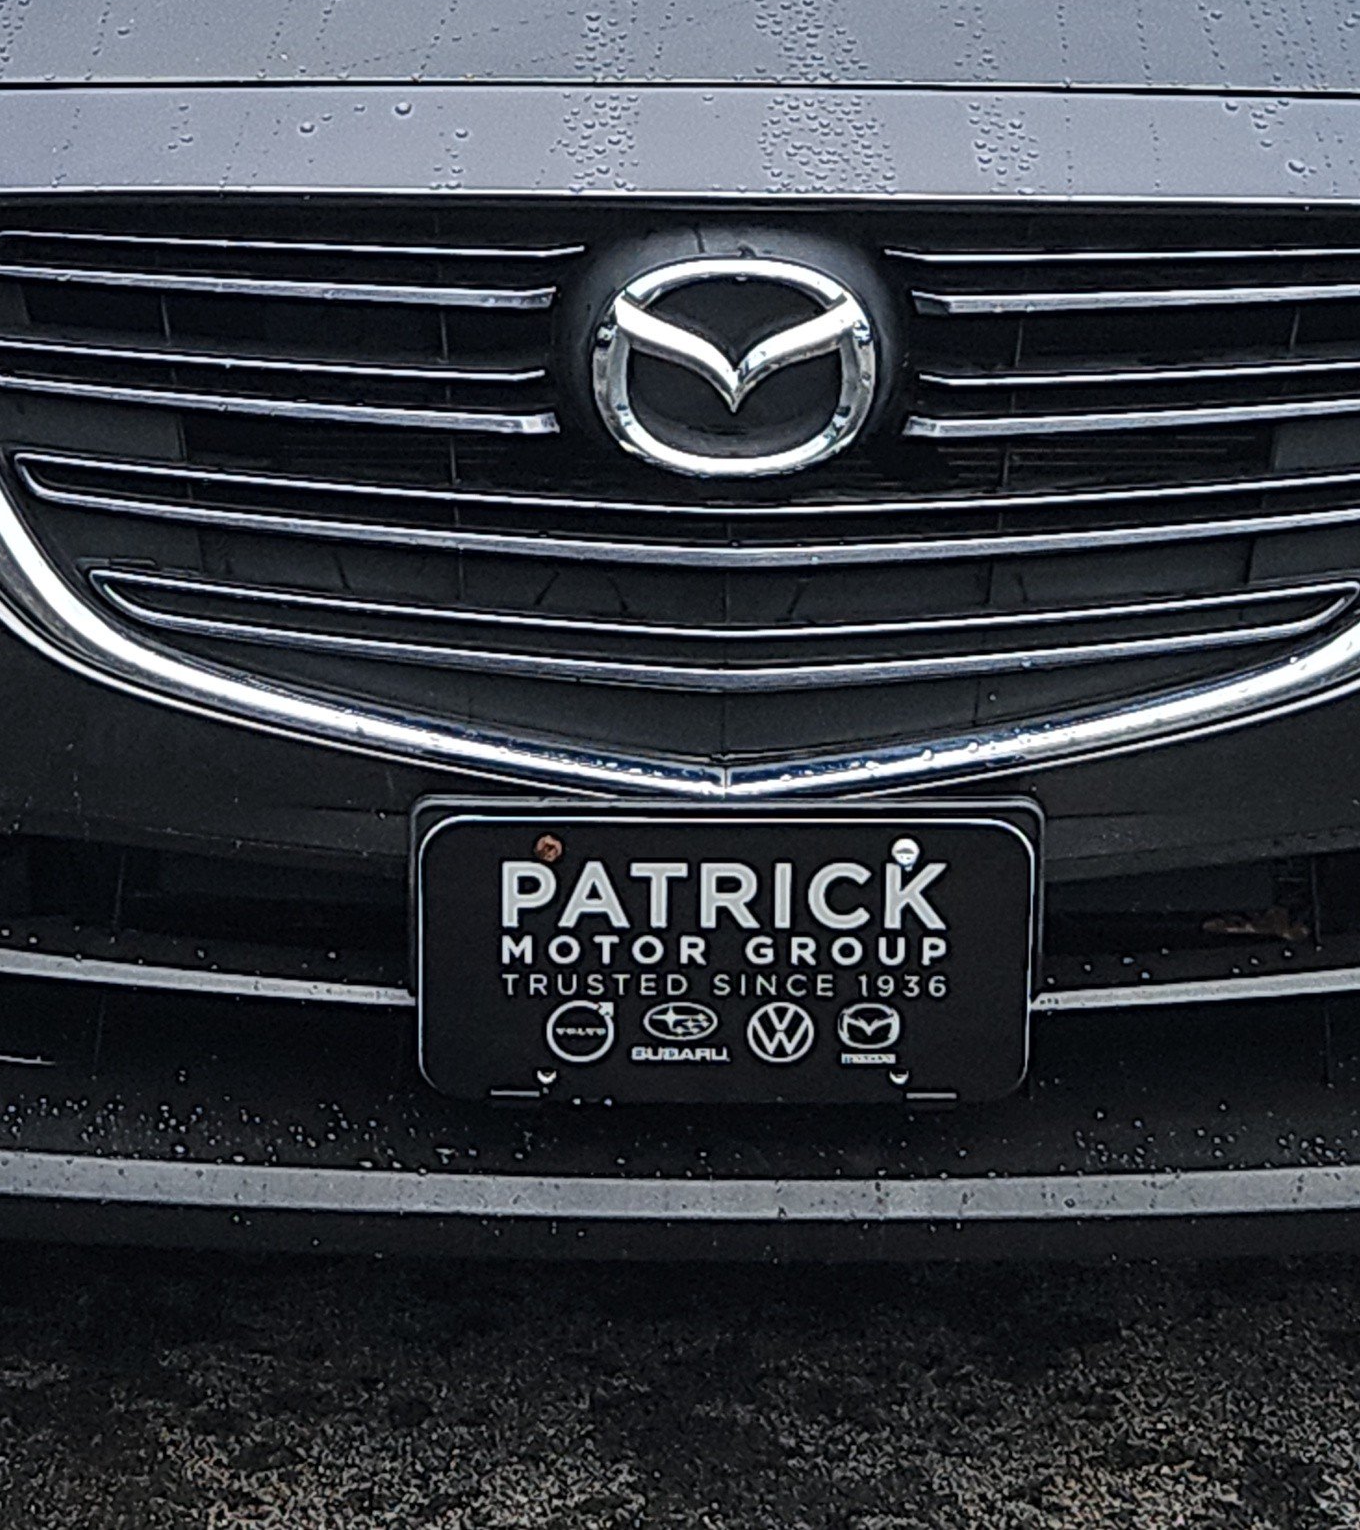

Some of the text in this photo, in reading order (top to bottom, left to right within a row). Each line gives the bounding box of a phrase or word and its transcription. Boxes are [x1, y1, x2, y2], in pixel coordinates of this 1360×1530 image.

[502, 860, 948, 930] PATRICK
[501, 934, 948, 967] MOTOR GROUP
[501, 972, 948, 998] TRUSTED SINCE 1936
